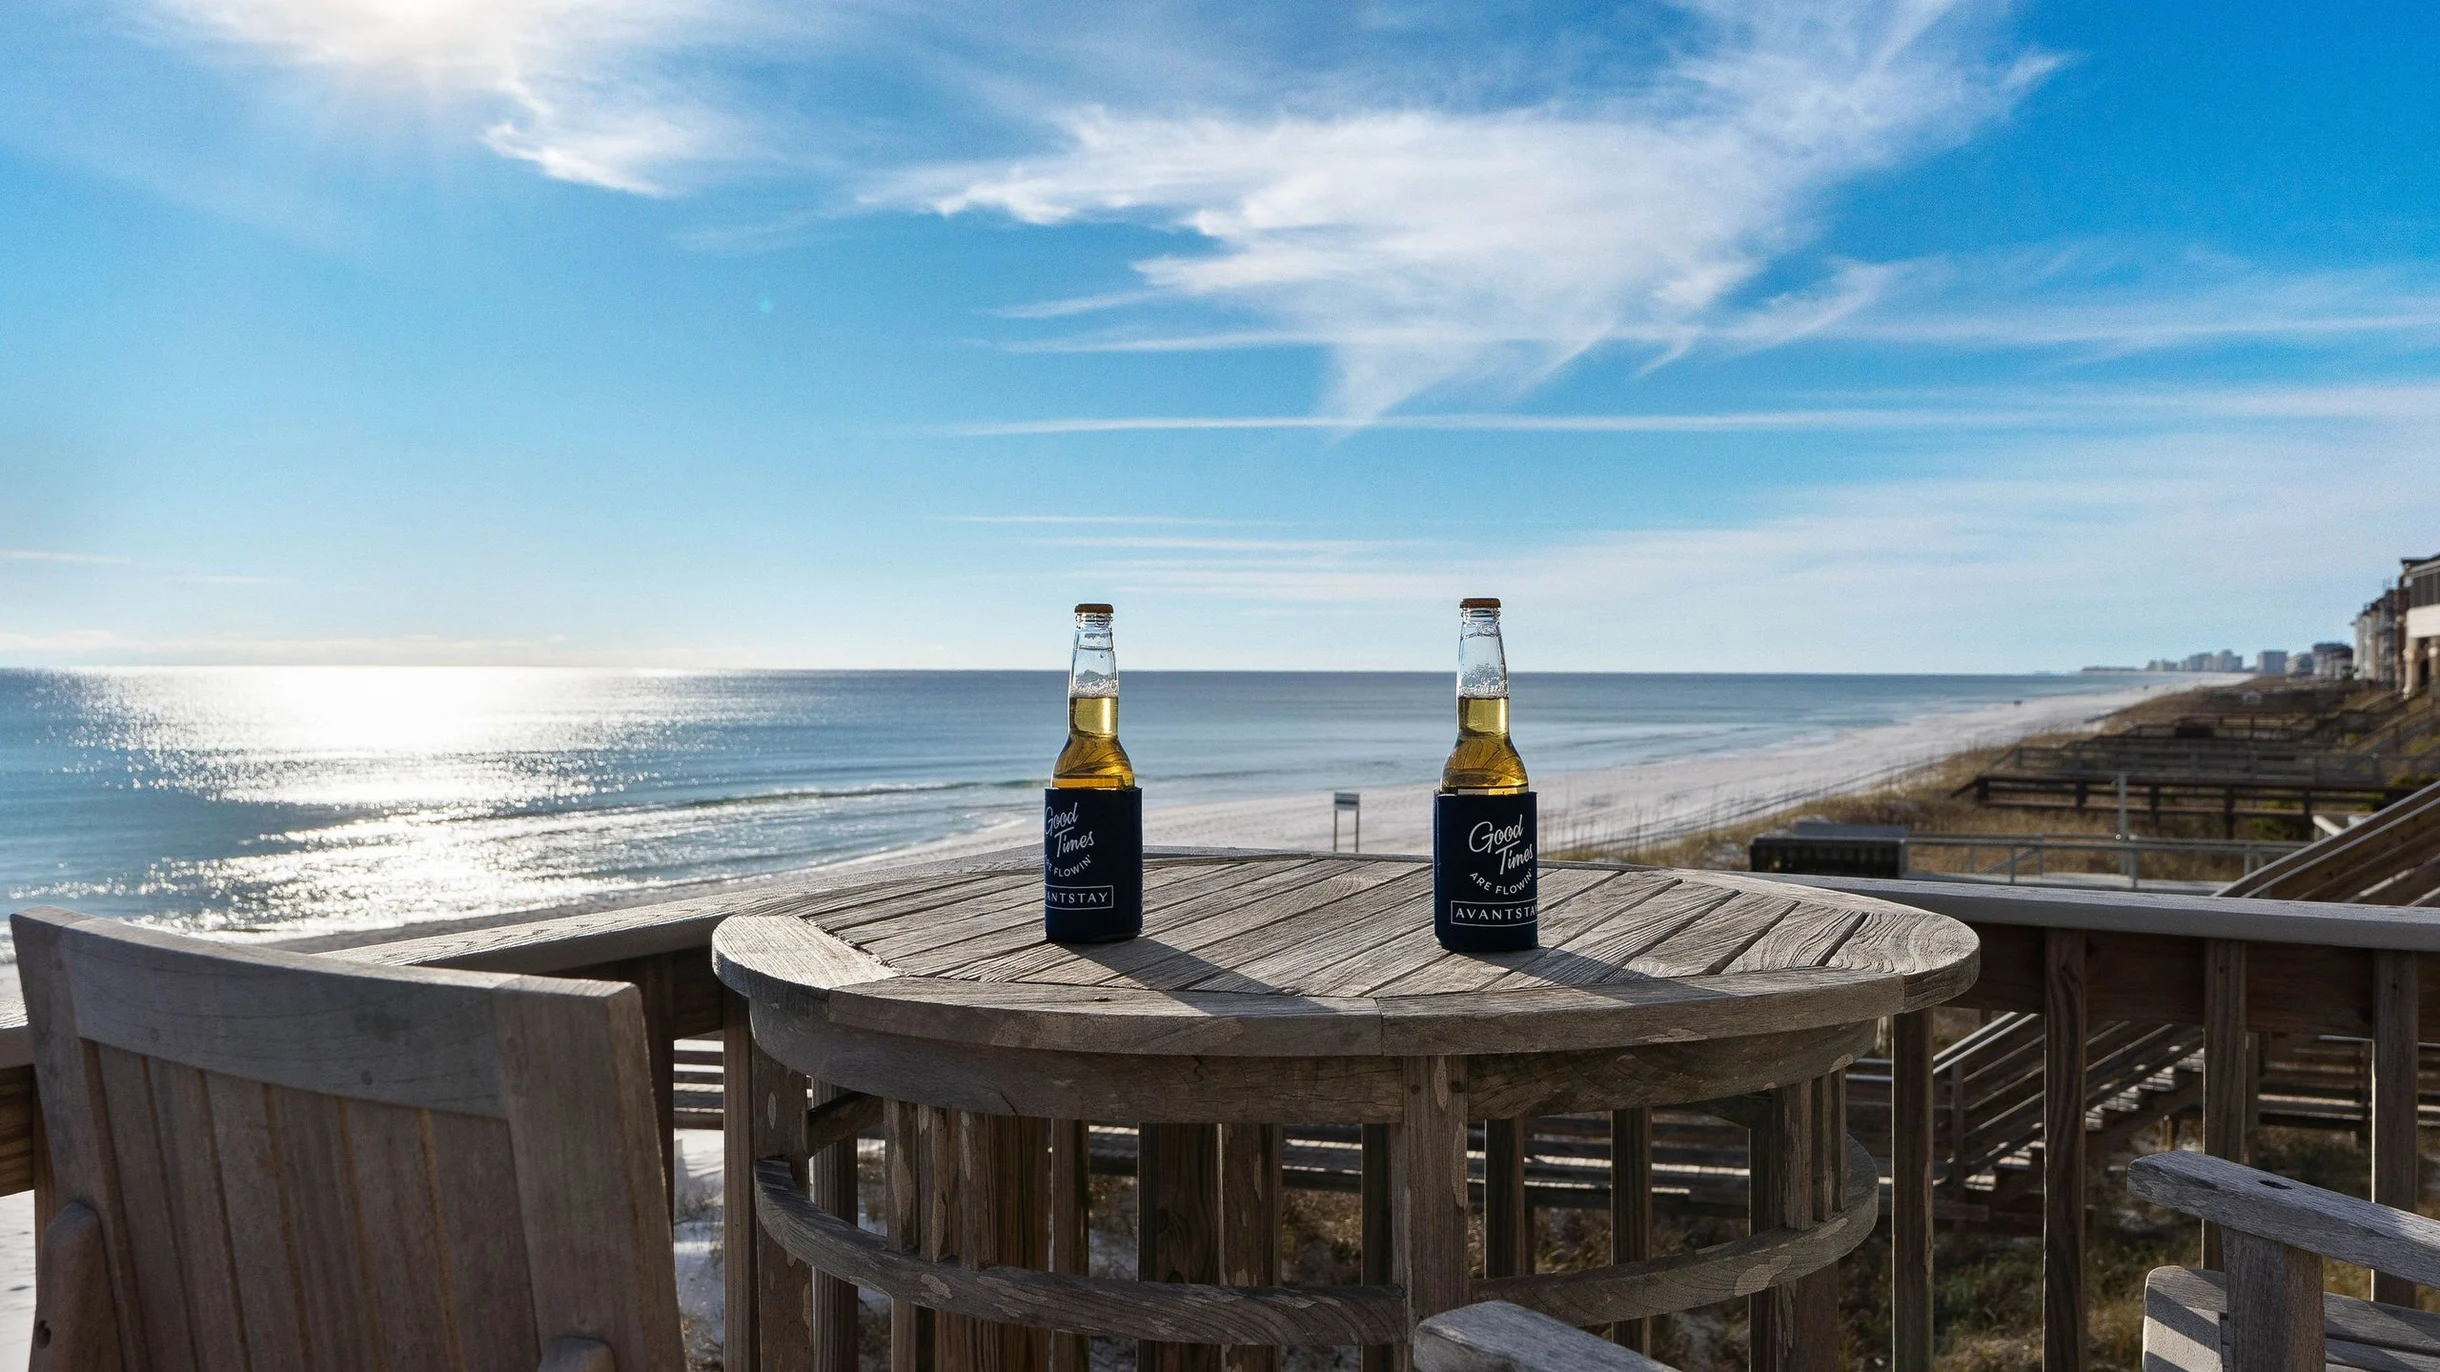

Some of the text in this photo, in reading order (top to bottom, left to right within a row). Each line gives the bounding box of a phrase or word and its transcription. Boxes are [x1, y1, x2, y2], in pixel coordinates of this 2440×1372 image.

[1045, 801, 1079, 837] Good
[1468, 813, 1524, 854] Good
[1053, 826, 1095, 858] Times
[1495, 840, 1533, 875] Times
[1053, 854, 1092, 878] FLOWIN'
[1469, 868, 1532, 895] ARE FLOWIN'
[1046, 891, 1108, 904] ANTSTAY
